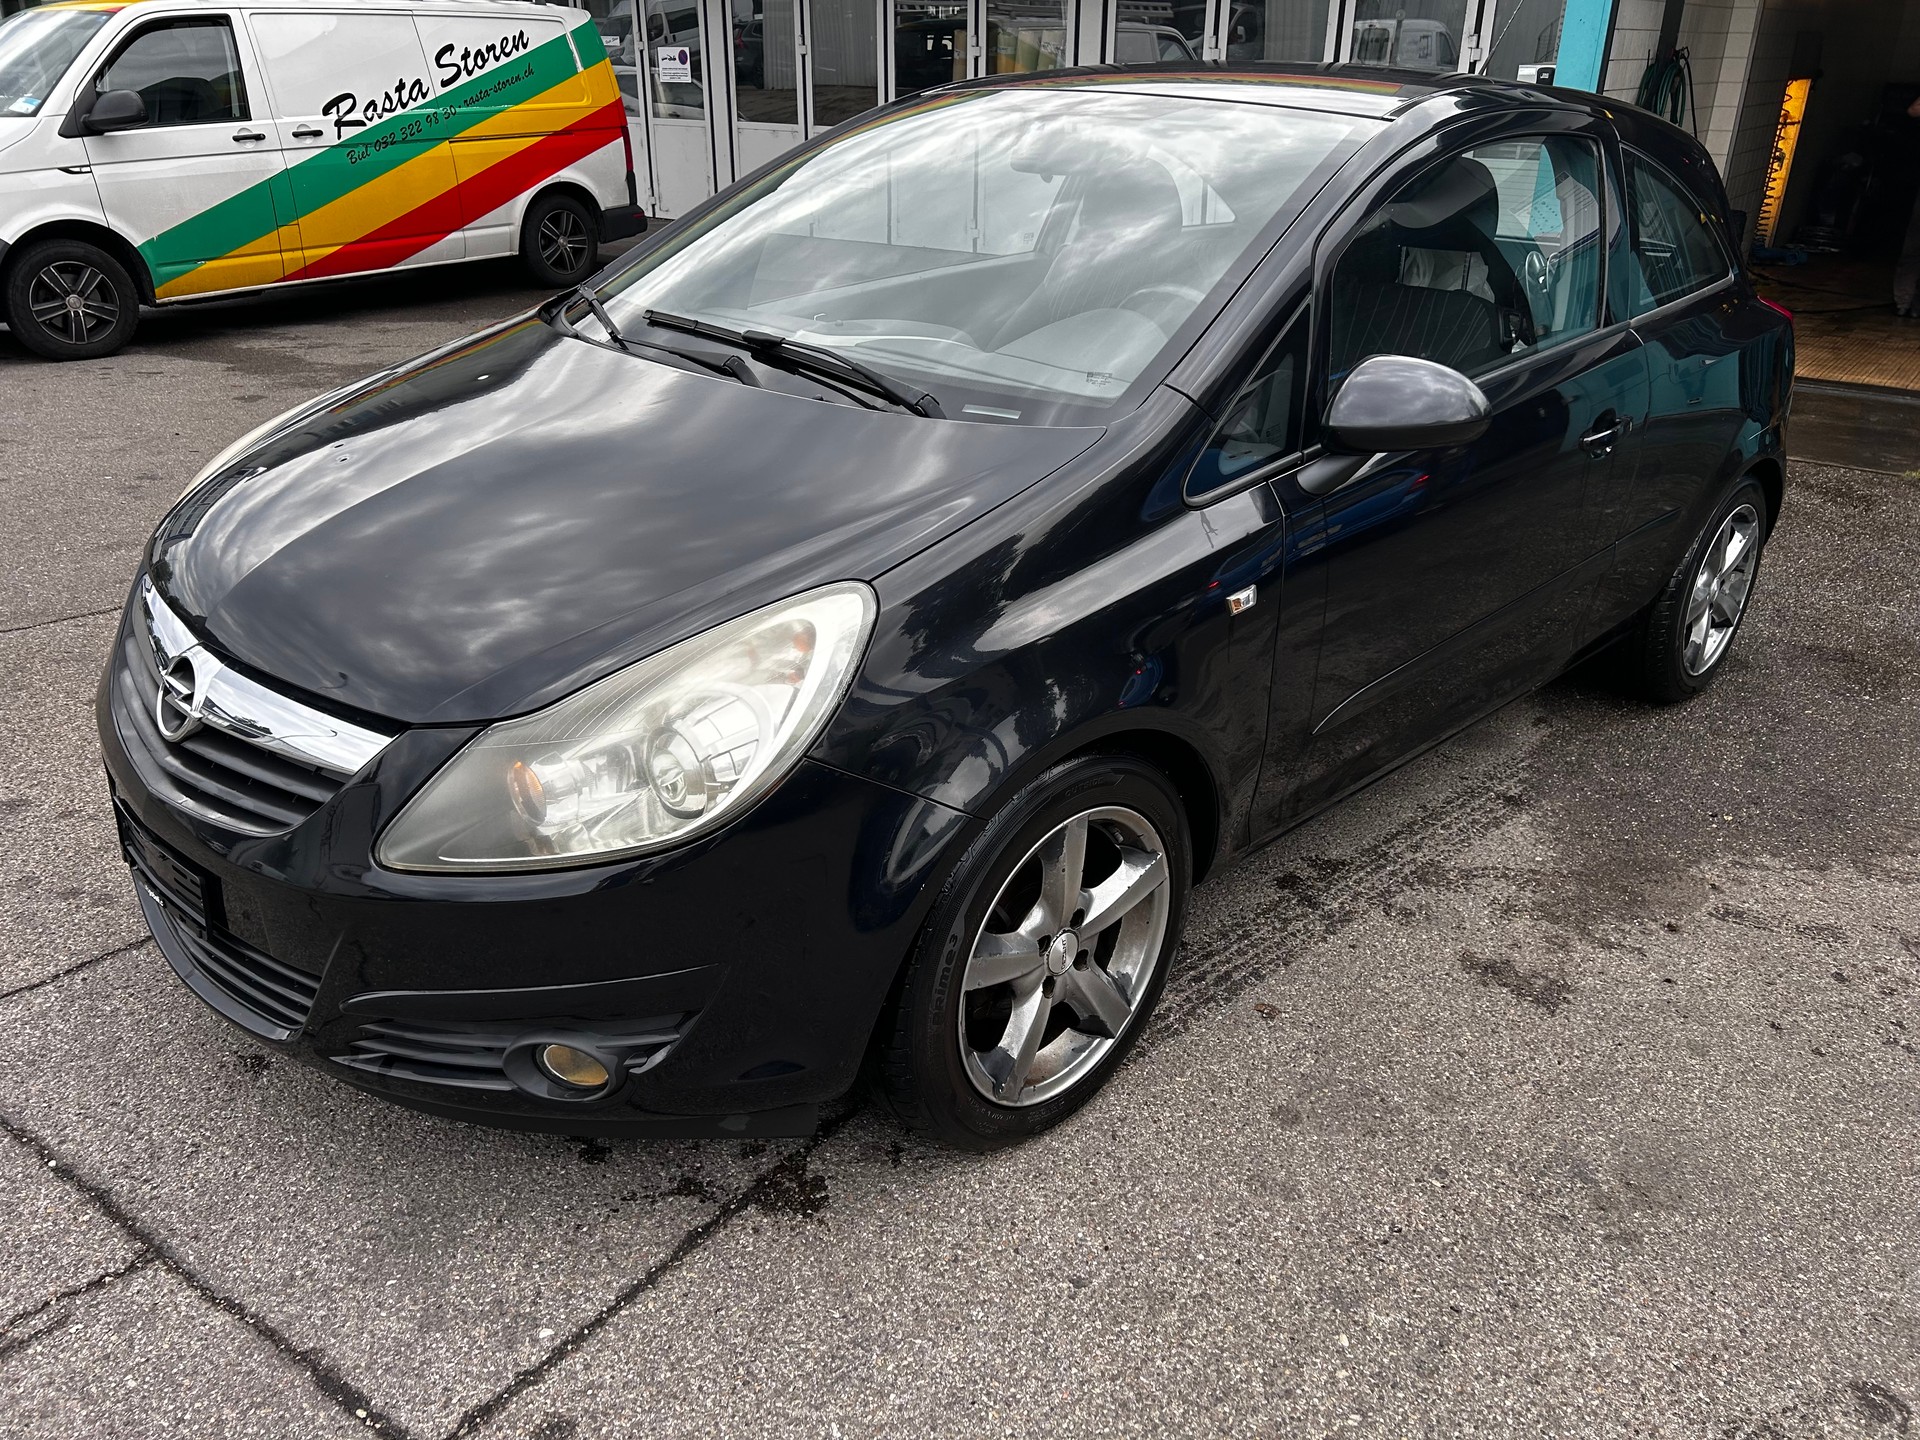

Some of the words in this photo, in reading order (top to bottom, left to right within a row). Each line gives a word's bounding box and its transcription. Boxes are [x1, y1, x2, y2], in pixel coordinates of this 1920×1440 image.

[322, 78, 430, 140] Rasta
[434, 29, 530, 88] Storen
[346, 143, 371, 165] Biel
[374, 132, 397, 152] 032
[400, 120, 423, 141] 322
[425, 112, 440, 128] 98
[442, 104, 457, 120] 30
[463, 62, 535, 107] rasta-storen.ch
